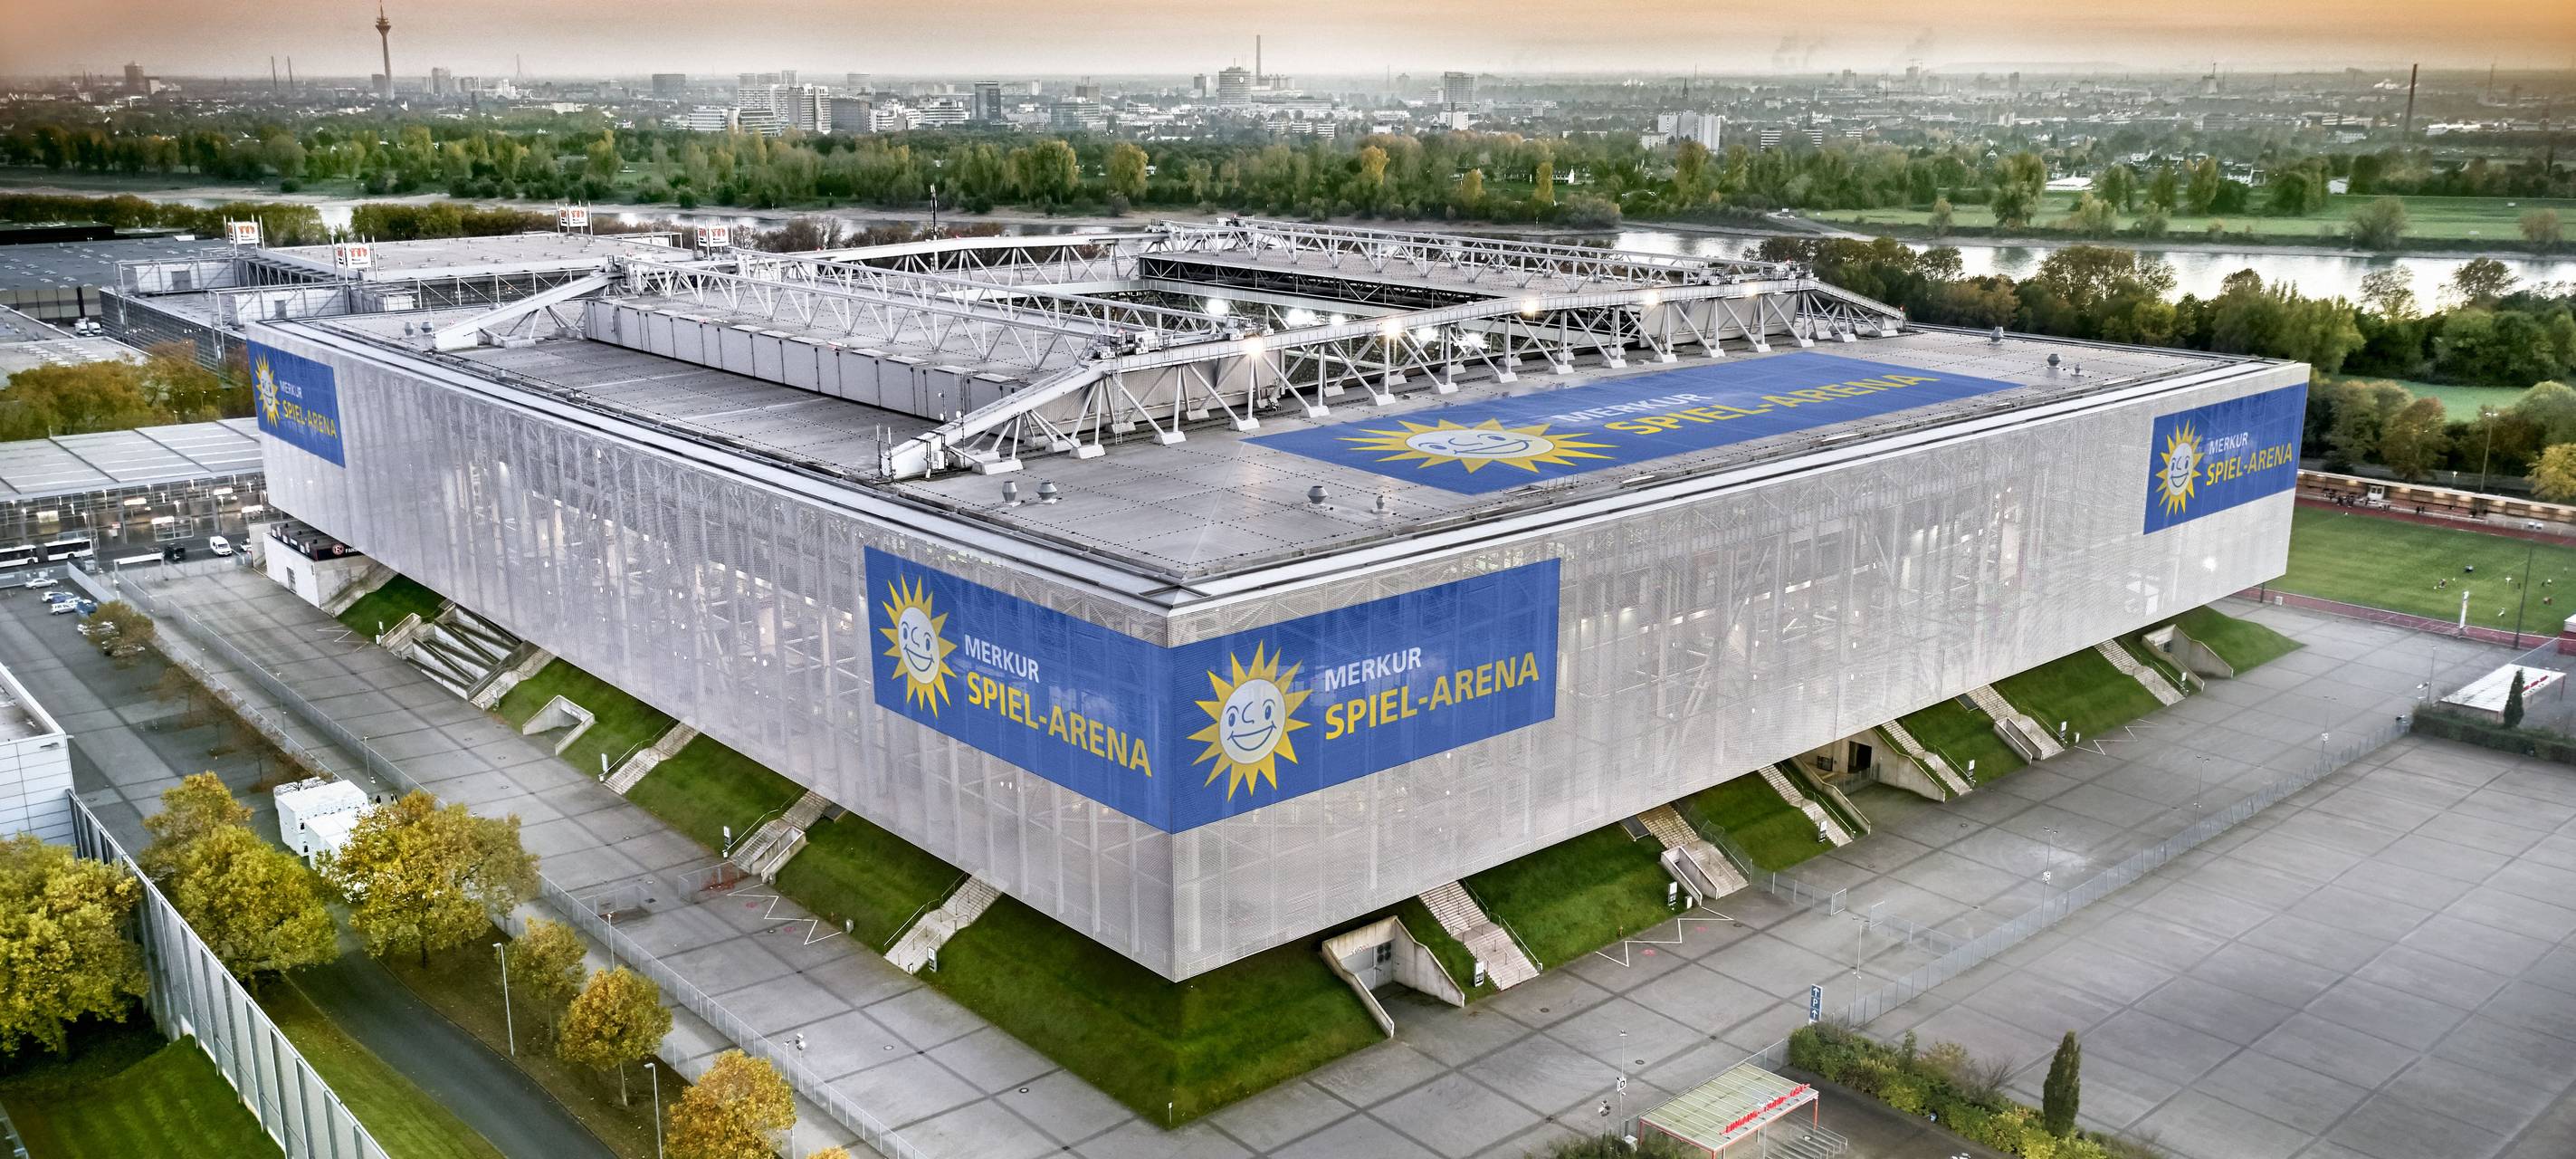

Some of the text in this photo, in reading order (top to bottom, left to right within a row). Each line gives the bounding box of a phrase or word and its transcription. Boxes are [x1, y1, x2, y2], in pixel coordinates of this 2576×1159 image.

[279, 380, 303, 398] MERKUR
[1550, 393, 1713, 423] MERKUR
[1604, 374, 1942, 436] SPIEL-ARENA
[282, 400, 338, 439] SPIEL-ARENA
[2206, 442, 2293, 486] SPIEL-ARENA
[2209, 432, 2248, 455] MERKUR
[964, 634, 1040, 683] MERKUR
[1324, 647, 1422, 692] MERKUR
[1325, 651, 1540, 740] SPIEL-ARENA
[967, 671, 1152, 778] SPIEL-ARENA
[1813, 998, 1818, 1007] P
